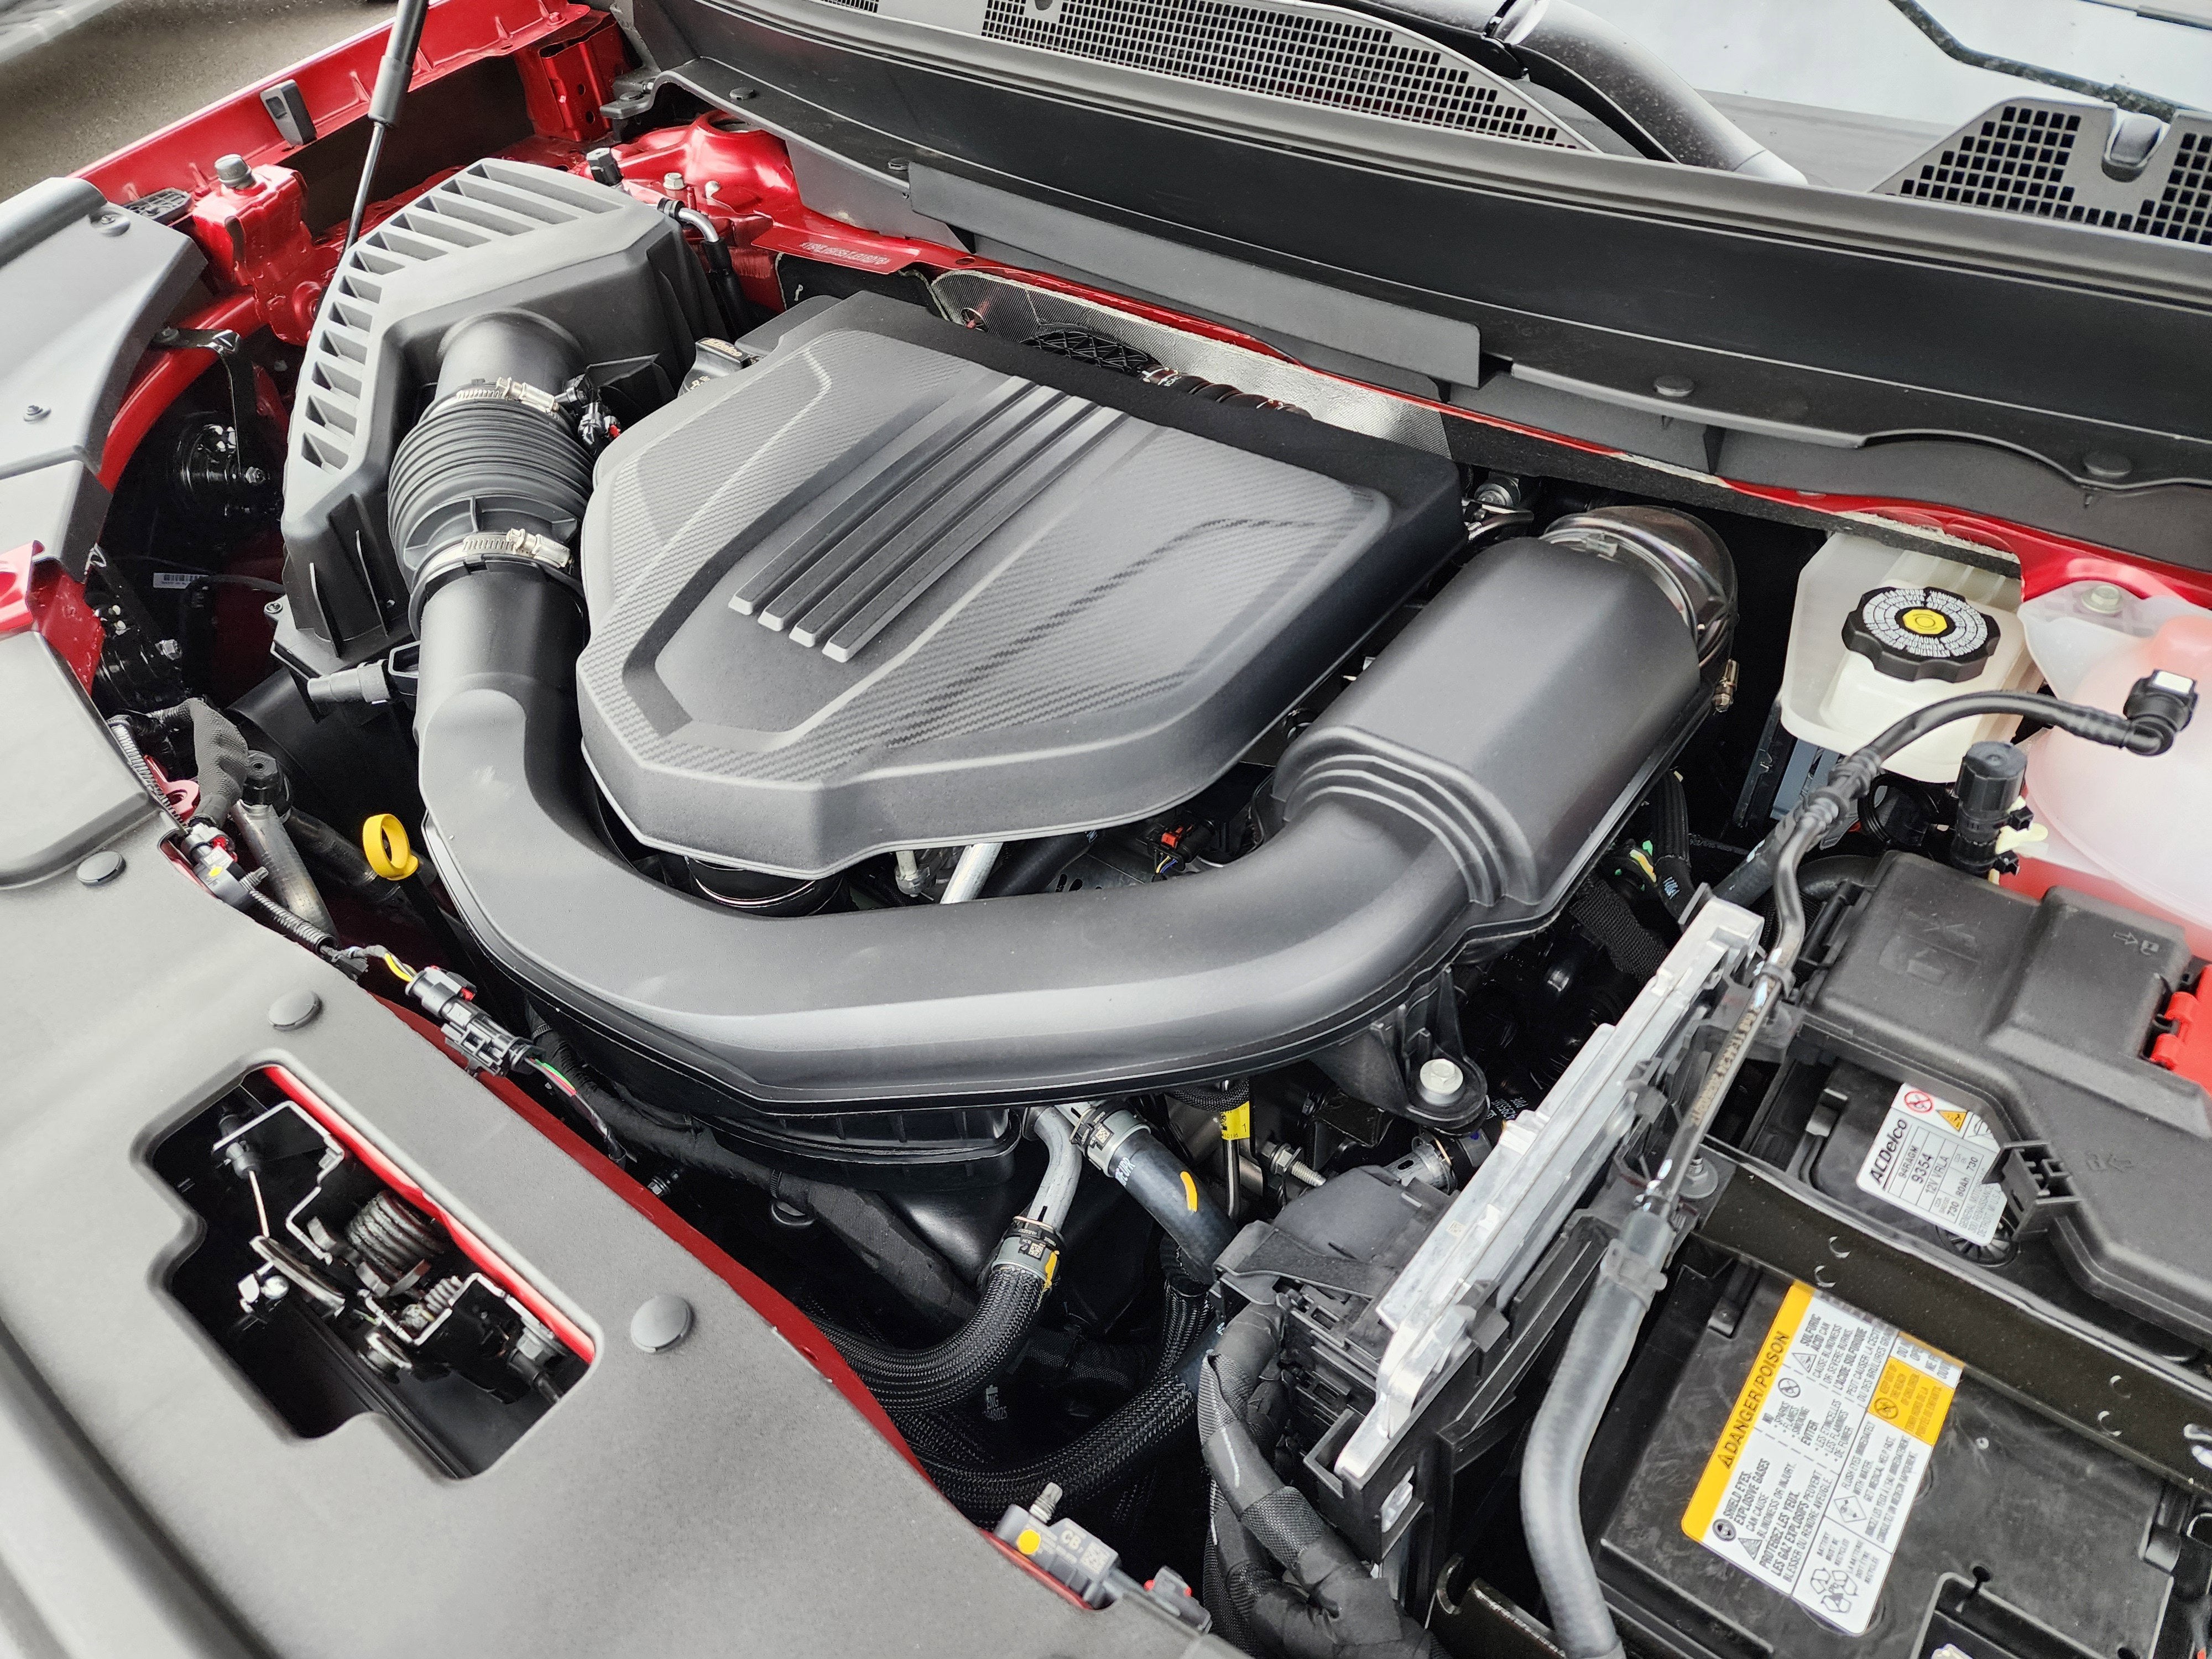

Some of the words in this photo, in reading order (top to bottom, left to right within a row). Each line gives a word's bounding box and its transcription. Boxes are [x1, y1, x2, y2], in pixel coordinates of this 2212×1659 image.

[1870, 1119, 1907, 1185] ACDelco
[1965, 1156, 1978, 1171] 730
[1911, 1152, 1933, 1183] 9354
[1924, 1177, 1939, 1194] 12V
[1933, 1155, 1949, 1177] VRLA
[1955, 1177, 1970, 1197] 80Ah
[1946, 1201, 1959, 1217] 730
[1972, 1182, 1994, 1220] RENAISSANCE
[1958, 1203, 1976, 1228] GENERAL
[1799, 1313, 1821, 1346] SULFURIC
[1810, 1334, 1824, 1352] ACID
[1818, 1321, 1830, 1335] CAN
[1866, 1326, 1881, 1347] CÉCIT
[1812, 1357, 1828, 1378] CAUSE
[1821, 1323, 1842, 1358] BLINDNESS
[1827, 1349, 1844, 1374] SEVERE
[1833, 1365, 1851, 1390] L'ACIDE
[1843, 1327, 1867, 1366] SULFURIQUE
[1864, 1345, 1874, 1355] LA
[1822, 1373, 1833, 1384] OR
[1853, 1354, 1869, 1380] CAUSER
[1727, 1332, 1790, 1457] DANGER/POISON
[1845, 1378, 1859, 1396] PEUT
[1856, 1391, 1867, 1402] OU
[1860, 1378, 1873, 1392] DES
[1782, 1405, 1799, 1429] FLAMES
[1814, 1434, 1827, 1448] LES
[1824, 1439, 1837, 1453] LES
[1833, 1447, 1845, 1458] DE
[1802, 1469, 1822, 1501] PEUVENT
[1841, 1469, 1854, 1489] FLUSH
[1848, 1455, 1861, 1471] EYES
[1863, 1488, 1874, 1503] GET
[1877, 1449, 1889, 1465] HELP
[1723, 1491, 1741, 1519] SHIELD
[1734, 1470, 1751, 1493] EYES.
[1733, 1483, 1759, 1525] EXPLOSIVE
[1751, 1458, 1770, 1484] GASES
[1756, 1499, 1780, 1538] BLINDNESS
[1773, 1487, 1783, 1500] OR
[1778, 1463, 1794, 1489] INJURY.
[1745, 1516, 1759, 1532] CAN
[1752, 1492, 1769, 1517] CAUSE
[1776, 1512, 1790, 1528] LES
[1784, 1500, 1809, 1543] EXPLOSIFS
[1801, 1509, 1819, 1538] RENDRE
[1777, 1541, 1792, 1560] GAZ
[1796, 1538, 1807, 1550] OU
[1770, 1558, 1785, 1577] LES
[1782, 1549, 1802, 1582] BLESSER
